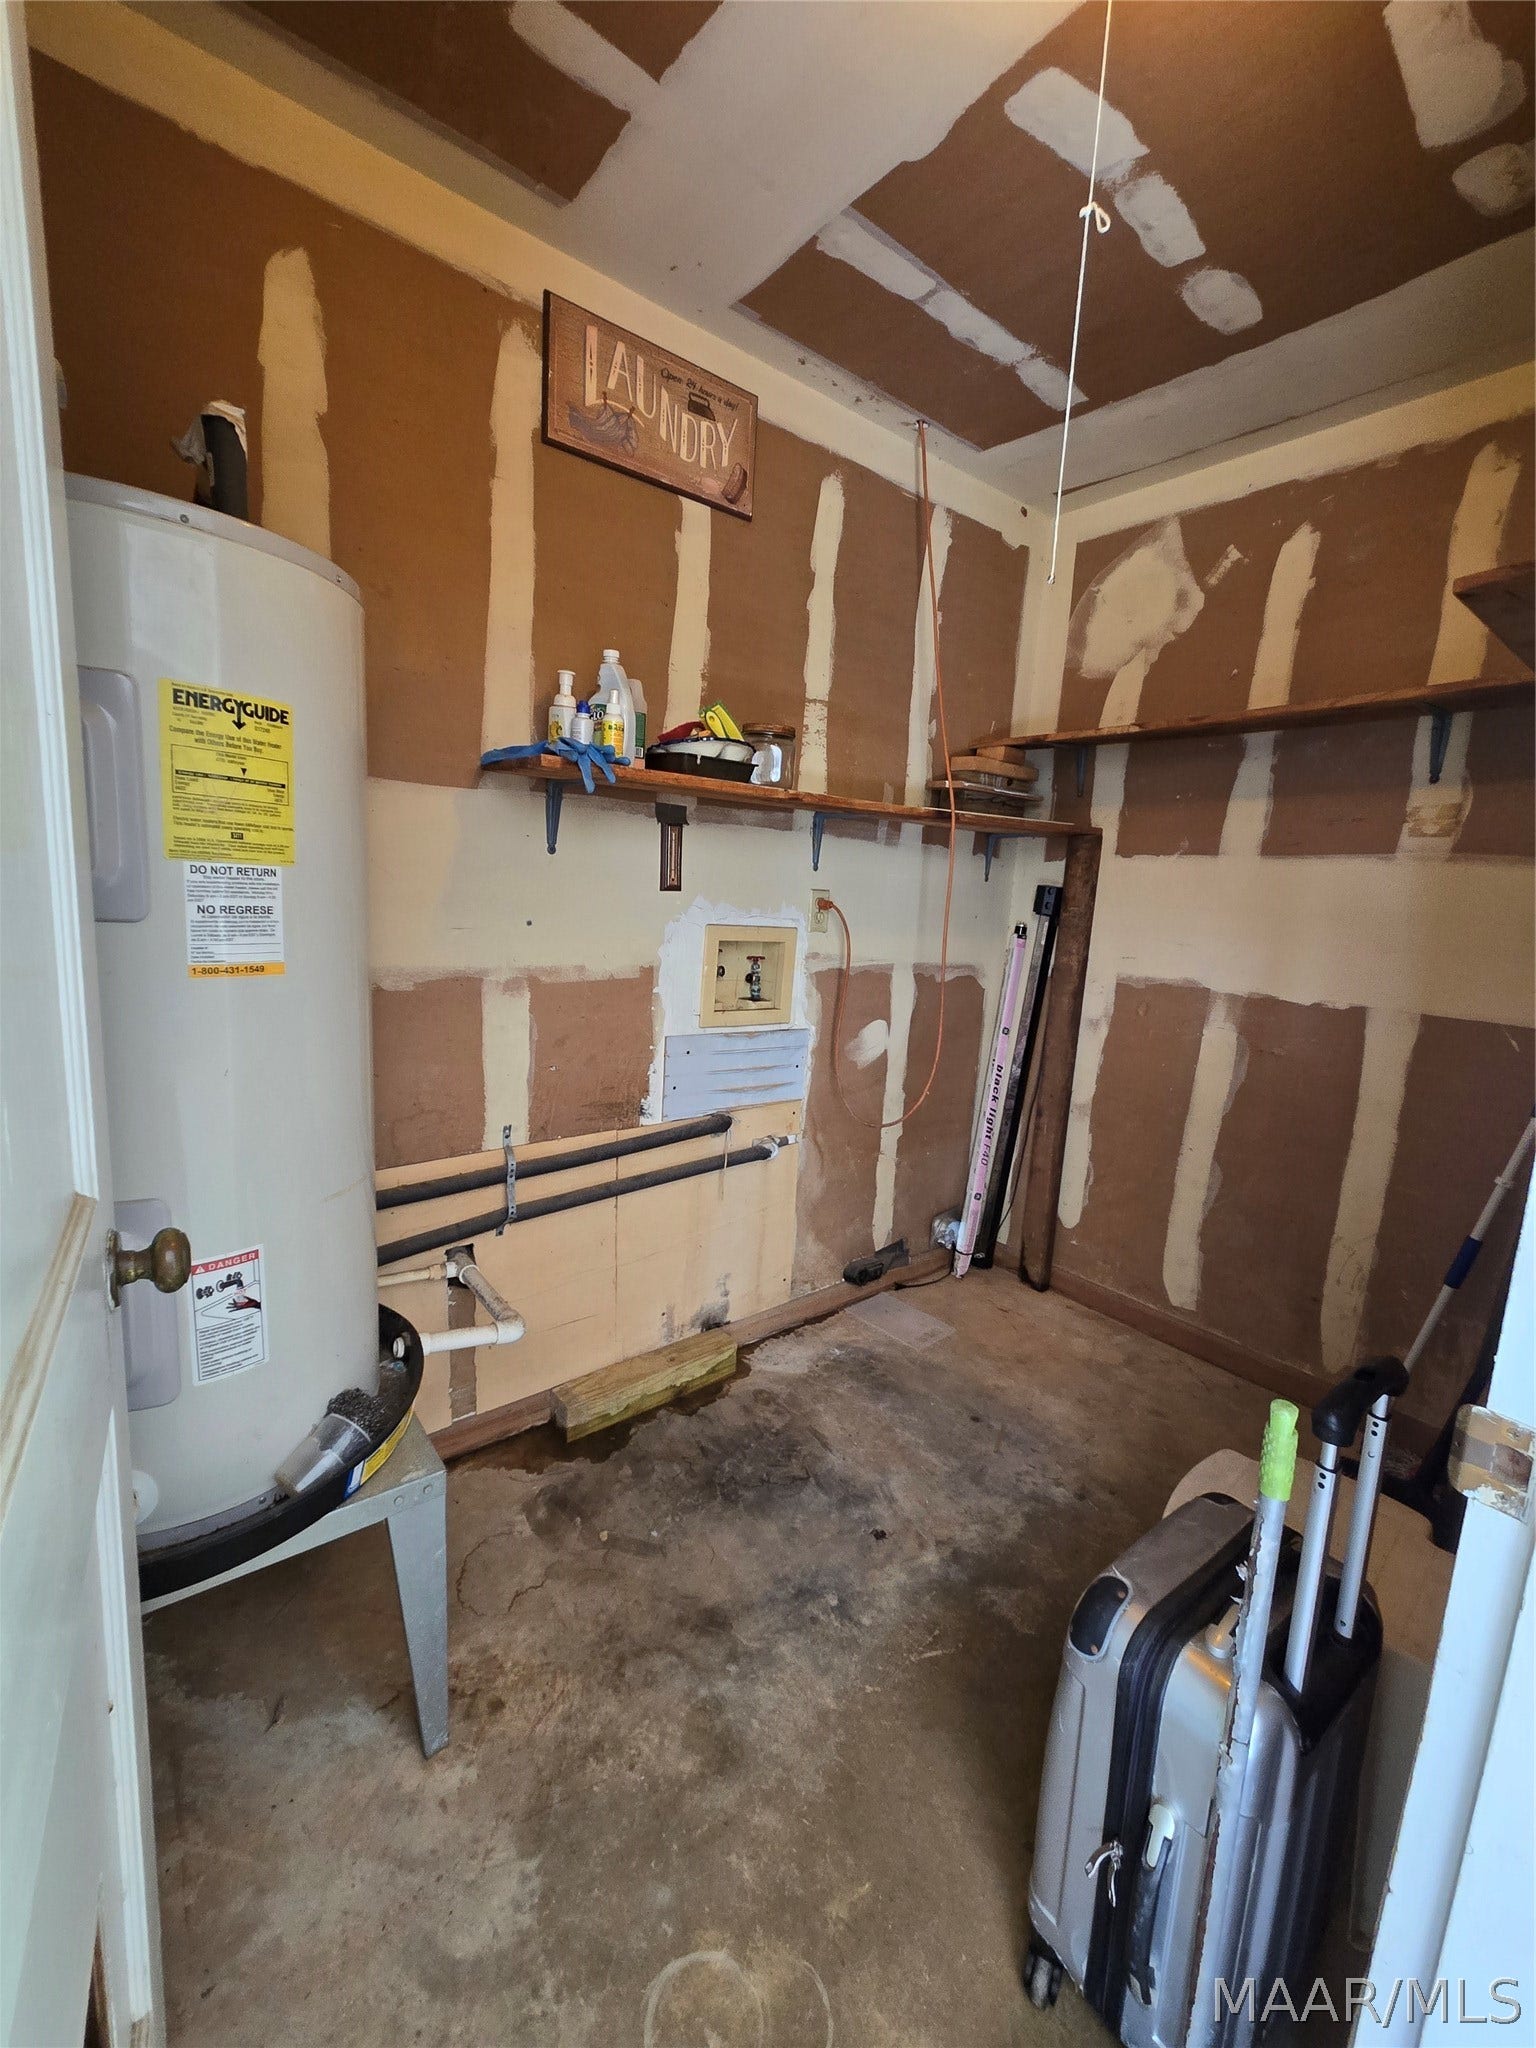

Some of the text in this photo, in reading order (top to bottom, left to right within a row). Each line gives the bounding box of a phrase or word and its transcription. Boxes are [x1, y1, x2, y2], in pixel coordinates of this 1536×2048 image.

[661, 368, 682, 384] Open
[585, 325, 738, 469] LAUNDRY
[190, 864, 207, 875] DO
[211, 865, 233, 876] NOT
[237, 867, 277, 878] RETURN
[197, 905, 274, 915] NO REGRESE
[191, 965, 265, 975] 1-800-431-1549
[991, 1064, 1004, 1103] black
[985, 1107, 997, 1140] light
[981, 1143, 991, 1166] F40
[208, 1252, 257, 1271] DANGER
